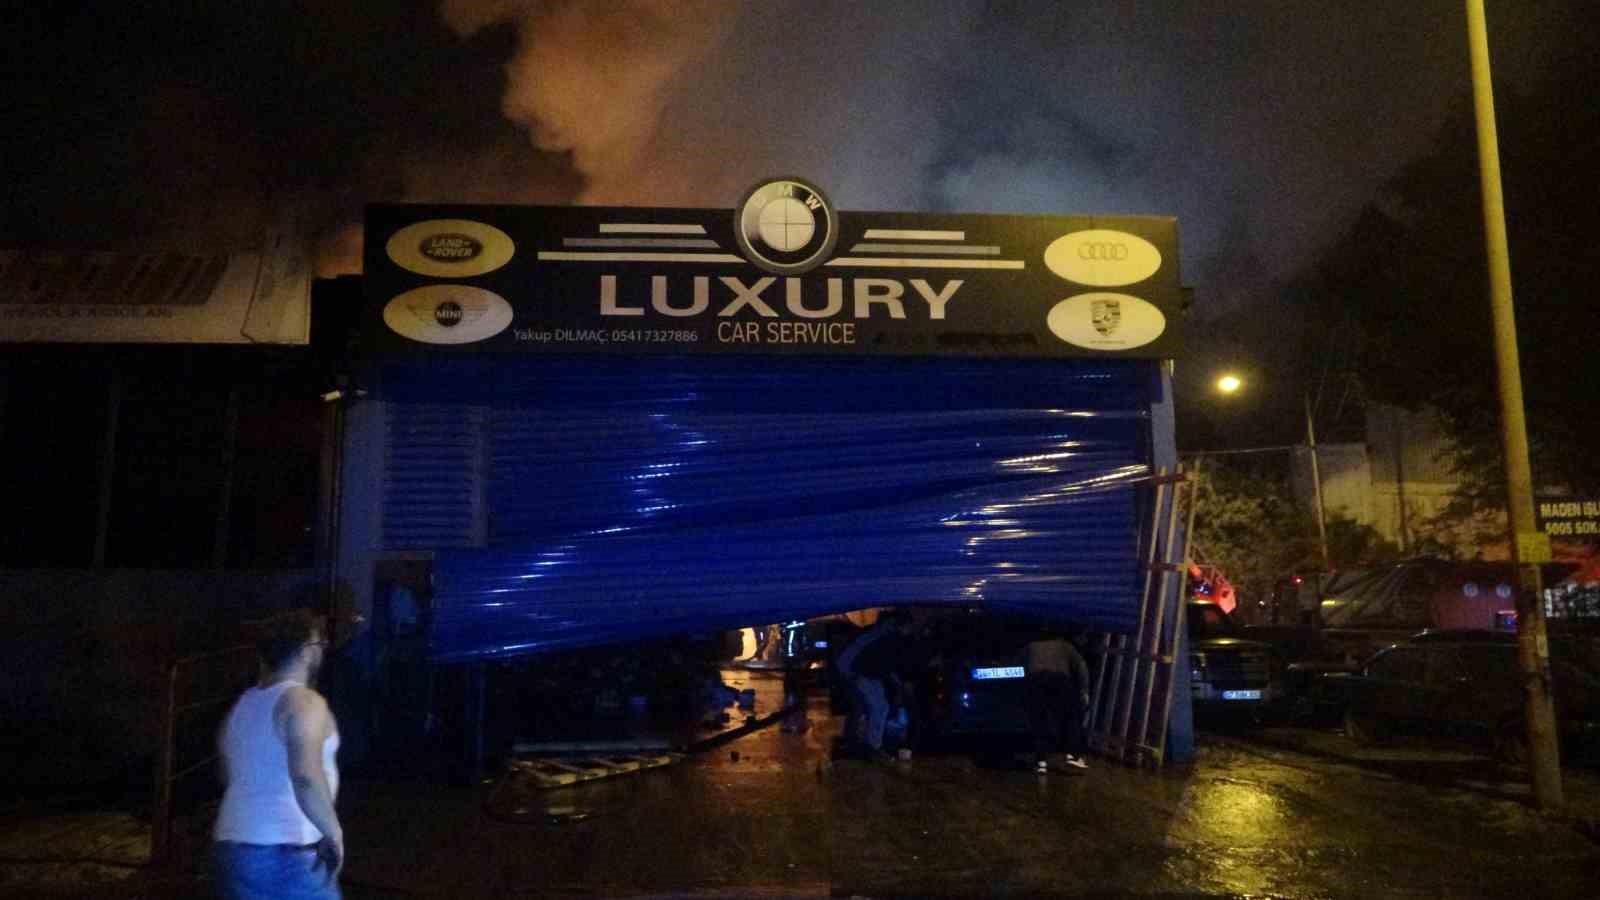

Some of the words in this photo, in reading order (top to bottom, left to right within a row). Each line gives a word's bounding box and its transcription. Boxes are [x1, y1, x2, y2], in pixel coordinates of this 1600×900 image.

[600, 275, 965, 320] LUXURY
[436, 310, 463, 320] MINI
[513, 328, 551, 343] Yakup
[717, 321, 760, 344] CAR
[767, 322, 856, 345] SERVICE
